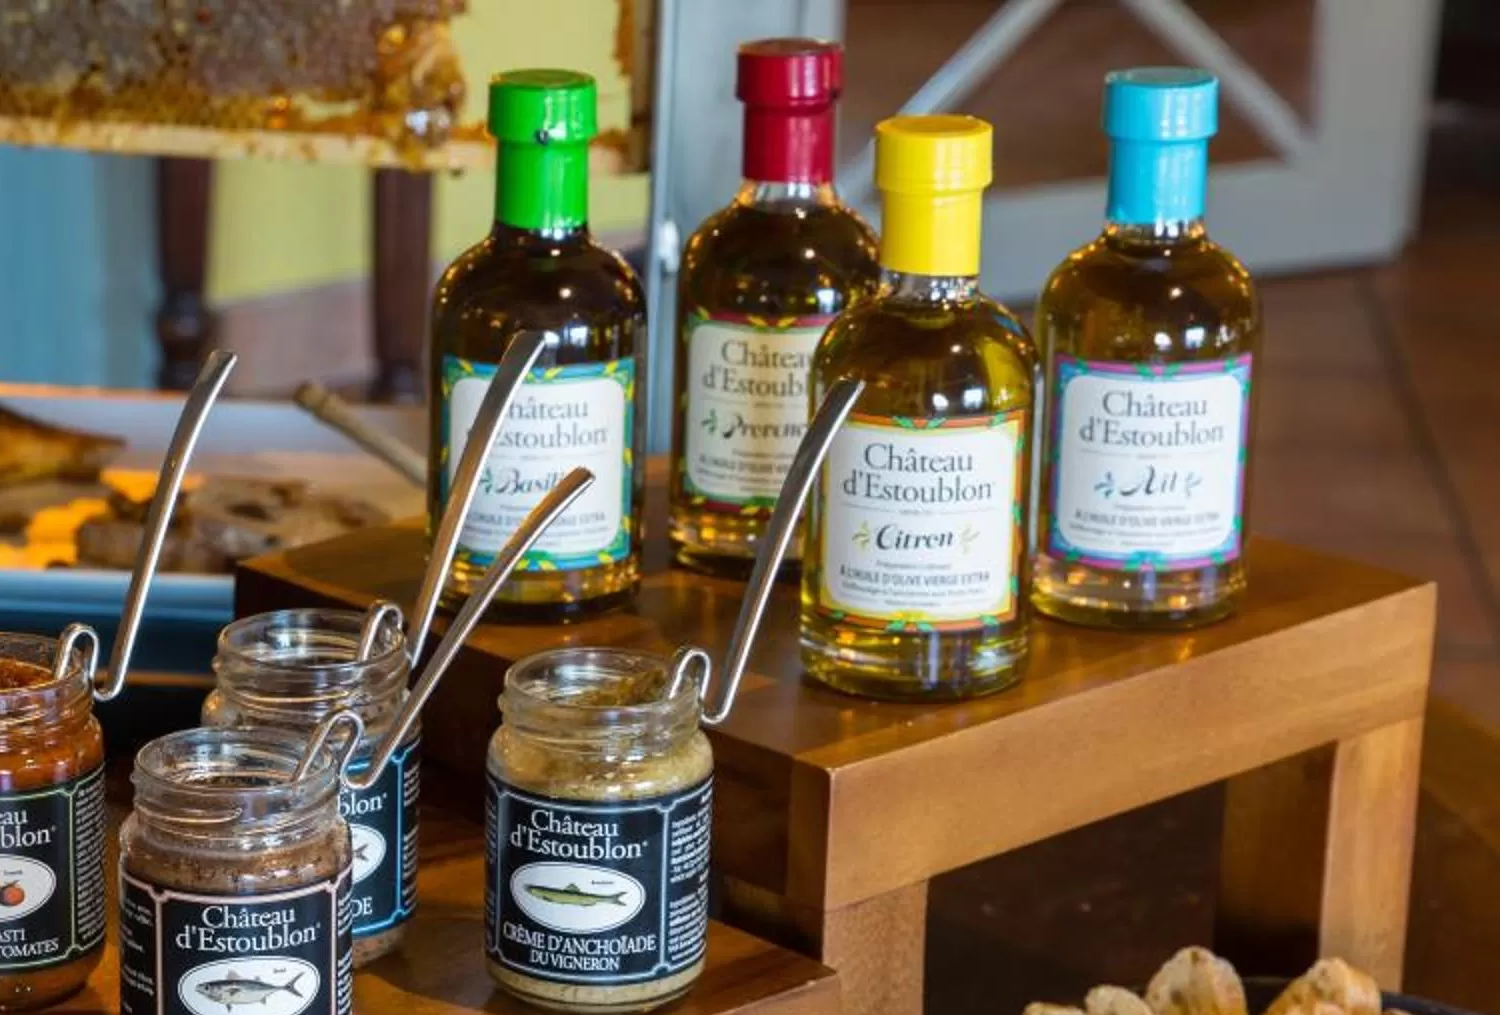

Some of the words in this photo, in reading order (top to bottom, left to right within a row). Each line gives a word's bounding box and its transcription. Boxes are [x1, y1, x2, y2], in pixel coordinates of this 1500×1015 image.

[721, 339, 810, 369] Châtea
[703, 363, 805, 398] d'Estoub
[506, 395, 588, 419] hâteau
[1102, 389, 1207, 418] Château
[498, 421, 609, 448] stoublon
[1079, 416, 1224, 448] d'Estoublon
[864, 443, 973, 473] Château
[496, 466, 564, 495] Basil
[843, 469, 992, 502] d'Estoublon
[530, 809, 618, 837] Château
[510, 823, 643, 860] d'Estoublon
[201, 905, 296, 929] Château
[175, 924, 317, 952] d'Estoublon
[530, 950, 549, 965] DU
[550, 953, 621, 972] VIGNERON
